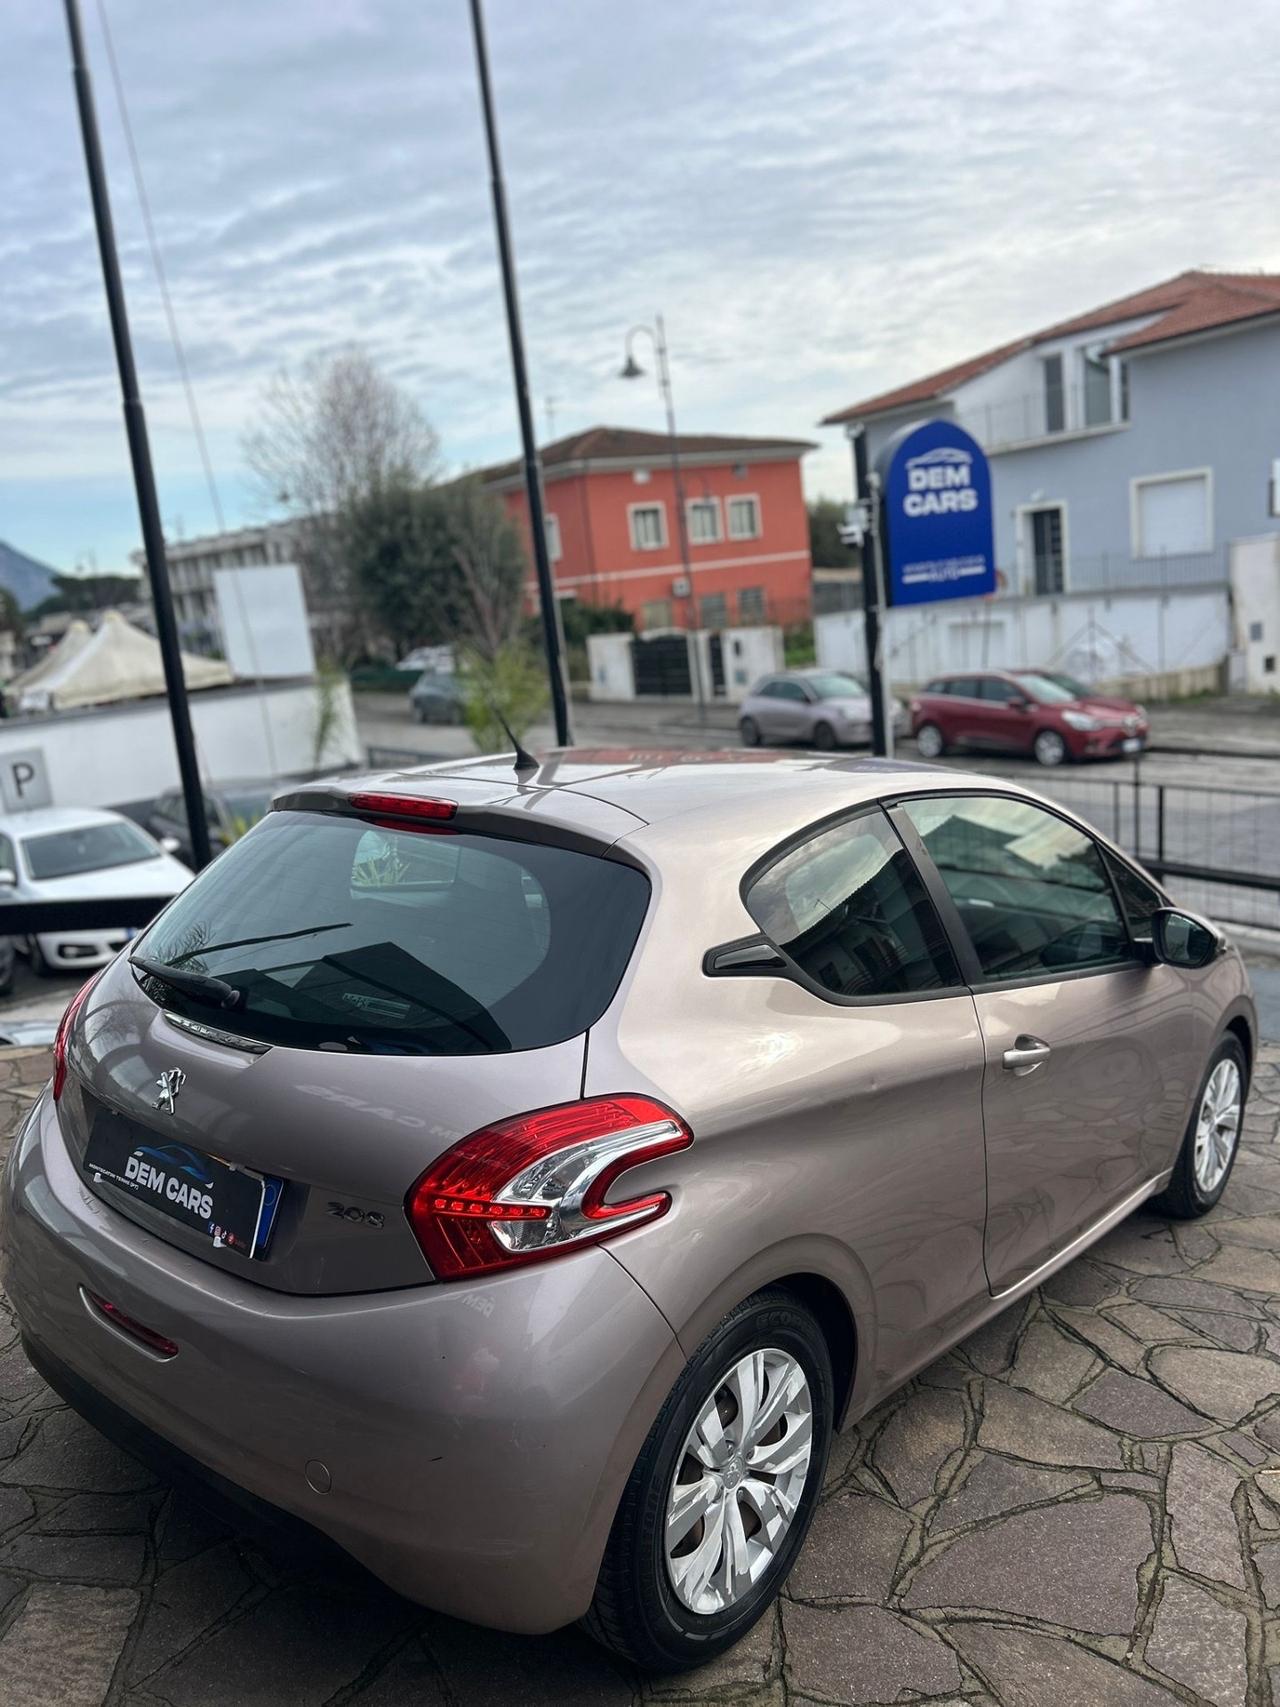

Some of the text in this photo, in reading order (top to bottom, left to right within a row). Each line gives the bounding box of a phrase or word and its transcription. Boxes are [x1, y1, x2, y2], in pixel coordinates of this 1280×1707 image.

[909, 465, 970, 491] DEM
[903, 488, 978, 517] CARS
[12, 761, 35, 798] P
[124, 1156, 213, 1219] DEM CARS
[328, 1201, 385, 1228] 208
